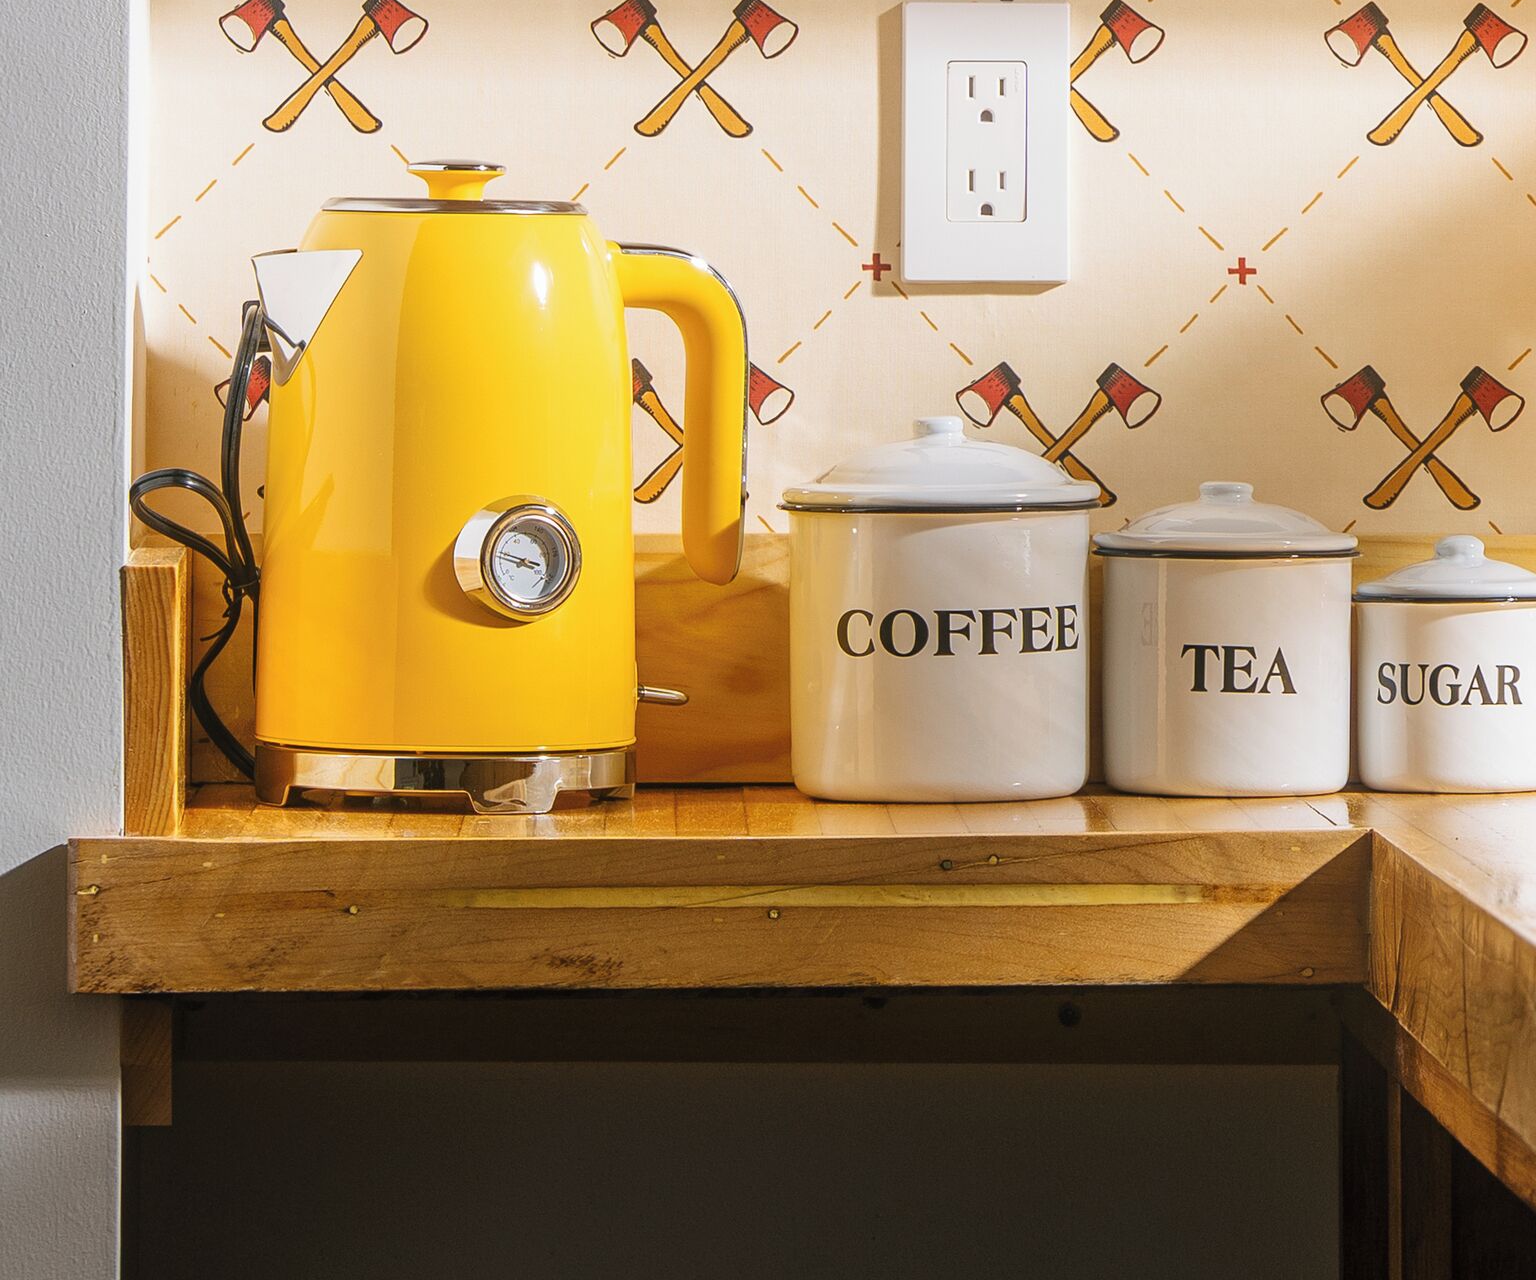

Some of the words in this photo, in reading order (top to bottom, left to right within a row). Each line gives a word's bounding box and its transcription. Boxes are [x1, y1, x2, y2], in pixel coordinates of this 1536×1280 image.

[836, 604, 1080, 658] COFFEE
[1181, 644, 1297, 696] TEA
[1376, 662, 1524, 707] SUGAR
